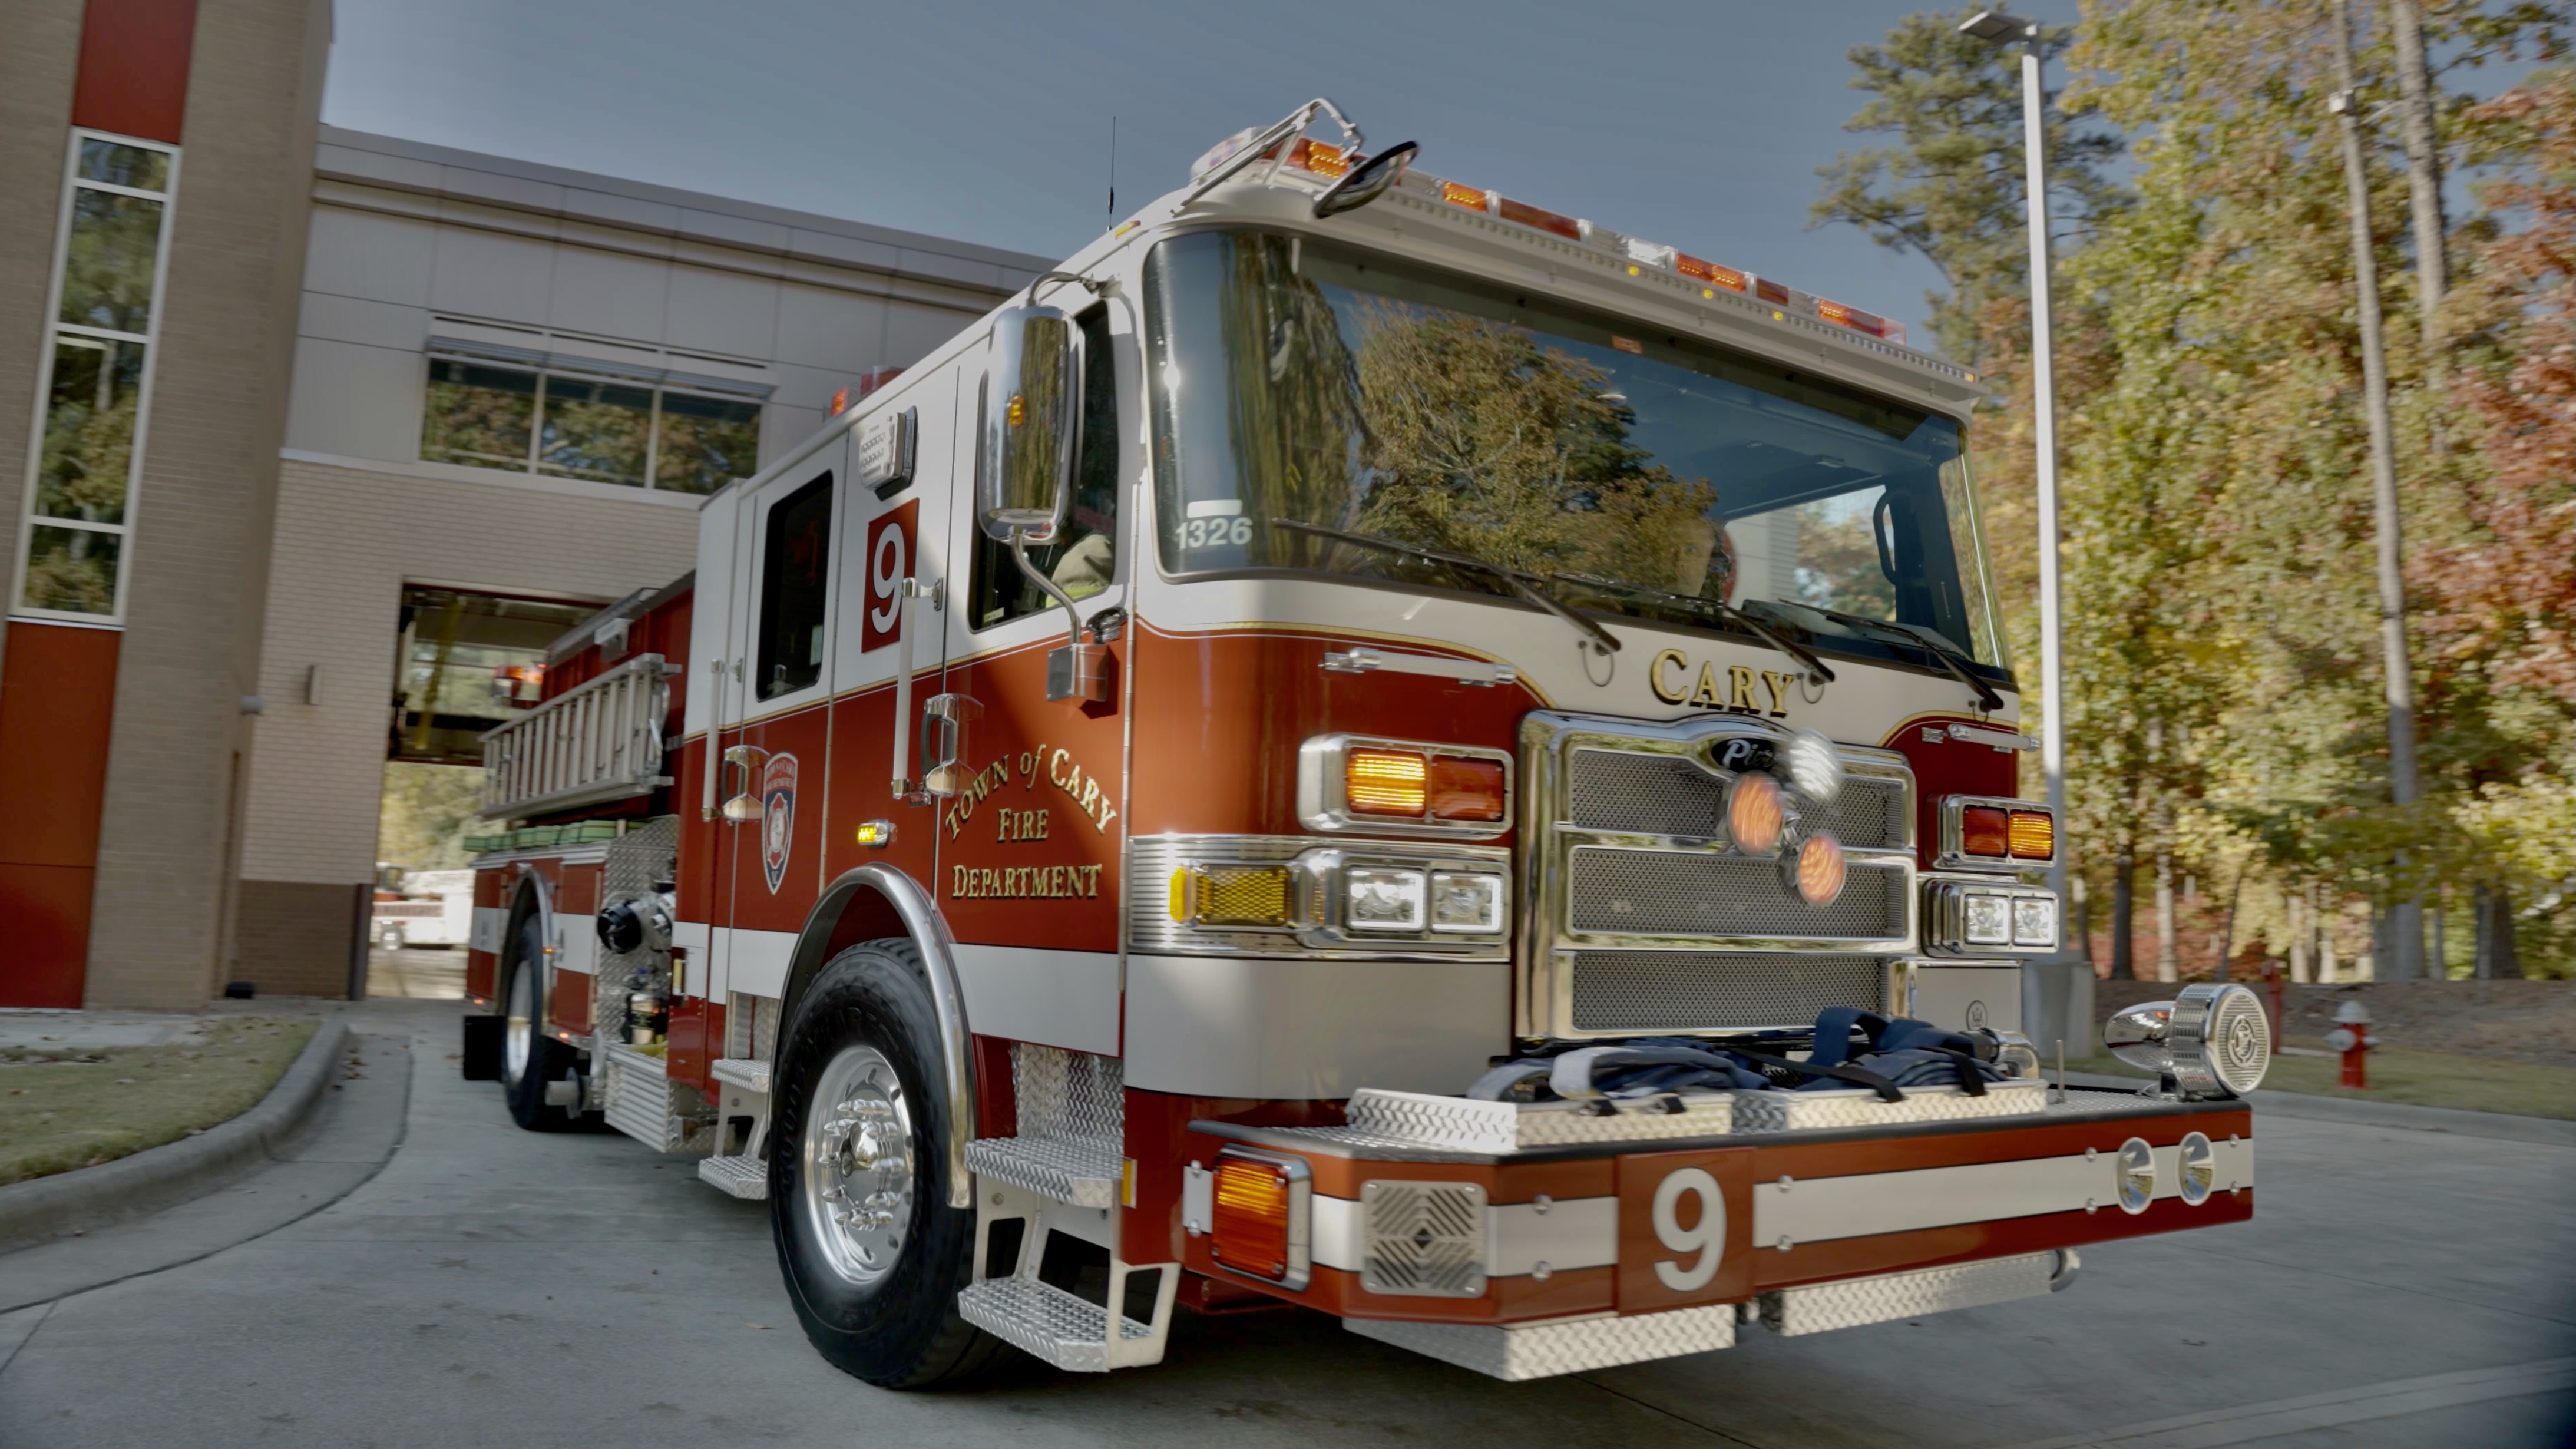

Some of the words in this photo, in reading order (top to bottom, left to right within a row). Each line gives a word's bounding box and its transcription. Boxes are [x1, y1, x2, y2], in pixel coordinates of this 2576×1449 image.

[1176, 517, 1253, 549] 1326
[871, 521, 905, 635] 9
[1651, 649, 1794, 717] CARY
[945, 754, 1009, 841] TOWN
[1019, 743, 1047, 789] of
[1050, 749, 1117, 835] CARY
[997, 808, 1049, 842] FIRE
[951, 864, 1103, 899] DEPARTMENT
[1652, 1166, 1727, 1292] 9
